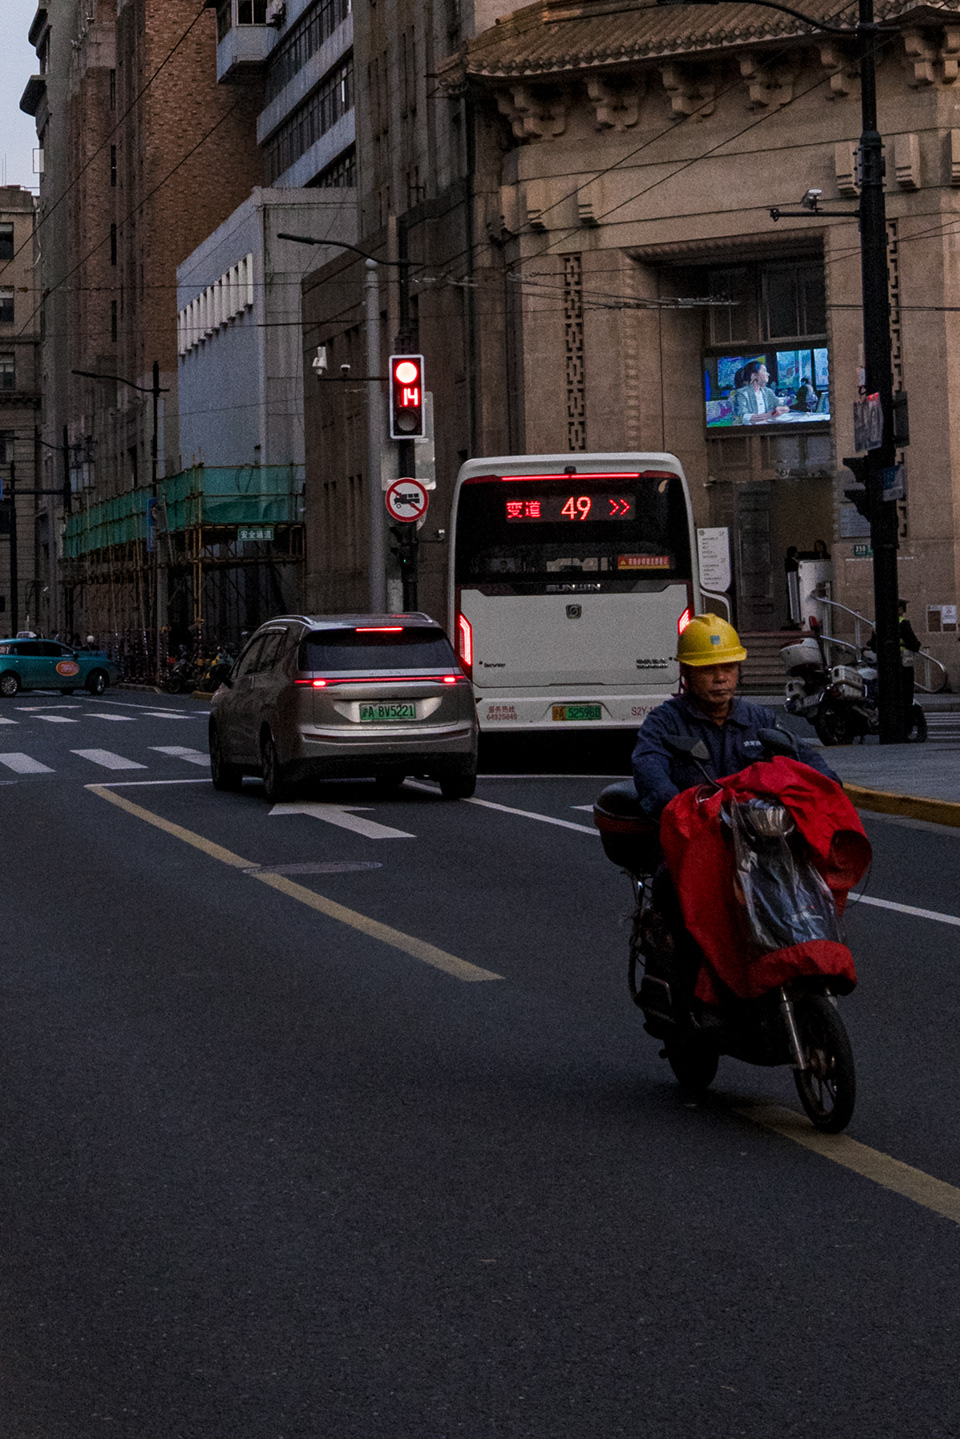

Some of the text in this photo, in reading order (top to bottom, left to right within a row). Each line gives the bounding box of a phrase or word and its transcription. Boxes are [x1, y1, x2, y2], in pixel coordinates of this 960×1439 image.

[403, 388, 419, 407] 14
[506, 496, 592, 520] 变道 49
[240, 530, 271, 539] 安全通道
